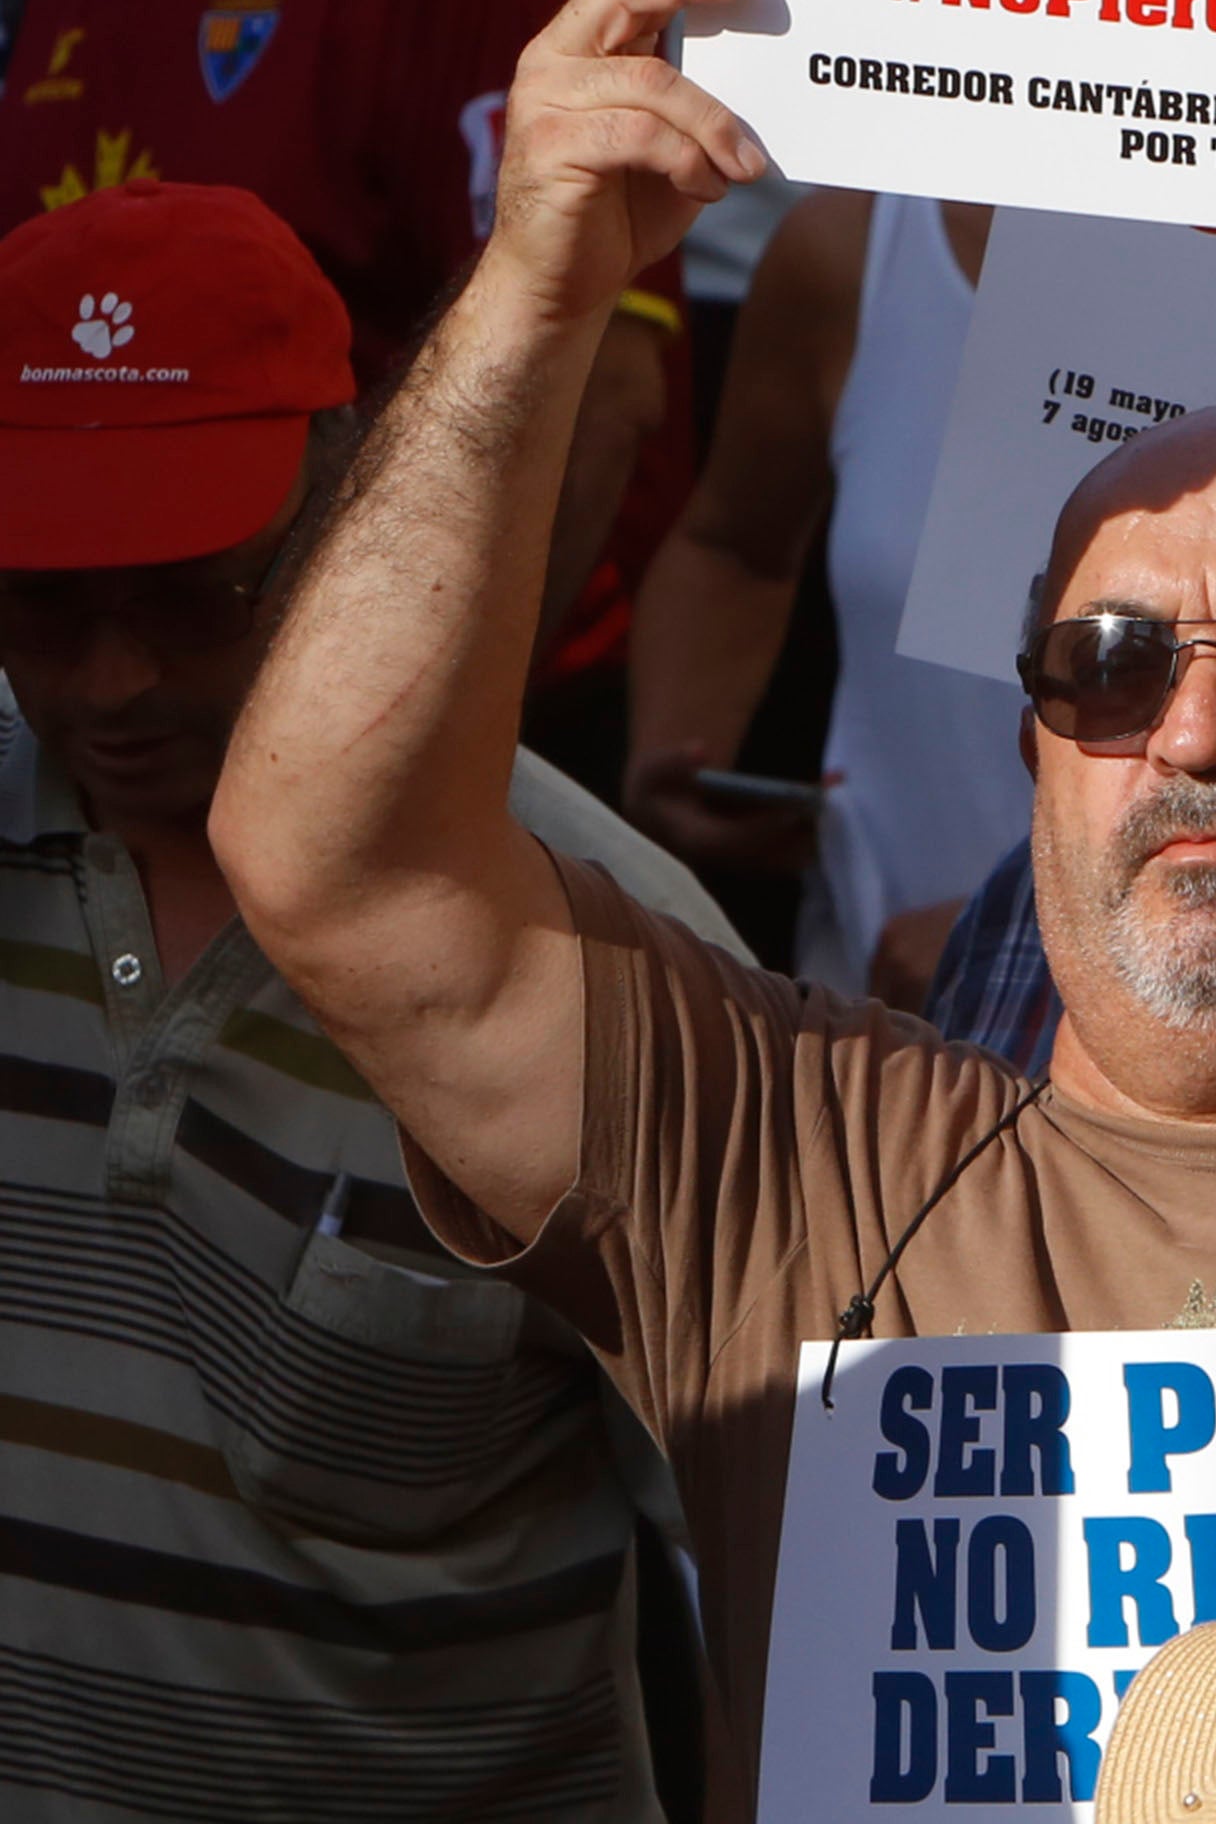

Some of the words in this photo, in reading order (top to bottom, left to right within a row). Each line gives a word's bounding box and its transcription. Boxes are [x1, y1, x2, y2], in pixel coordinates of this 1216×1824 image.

[809, 53, 1014, 105] CORREDOR
[1120, 129, 1197, 166] POR
[20, 364, 190, 383] bonmascota.com
[1048, 368, 1096, 400] (19
[1041, 399, 1062, 425] 7
[872, 1363, 1076, 1501] SER
[890, 1514, 1037, 1653] NO
[869, 1668, 1141, 1805] DER
